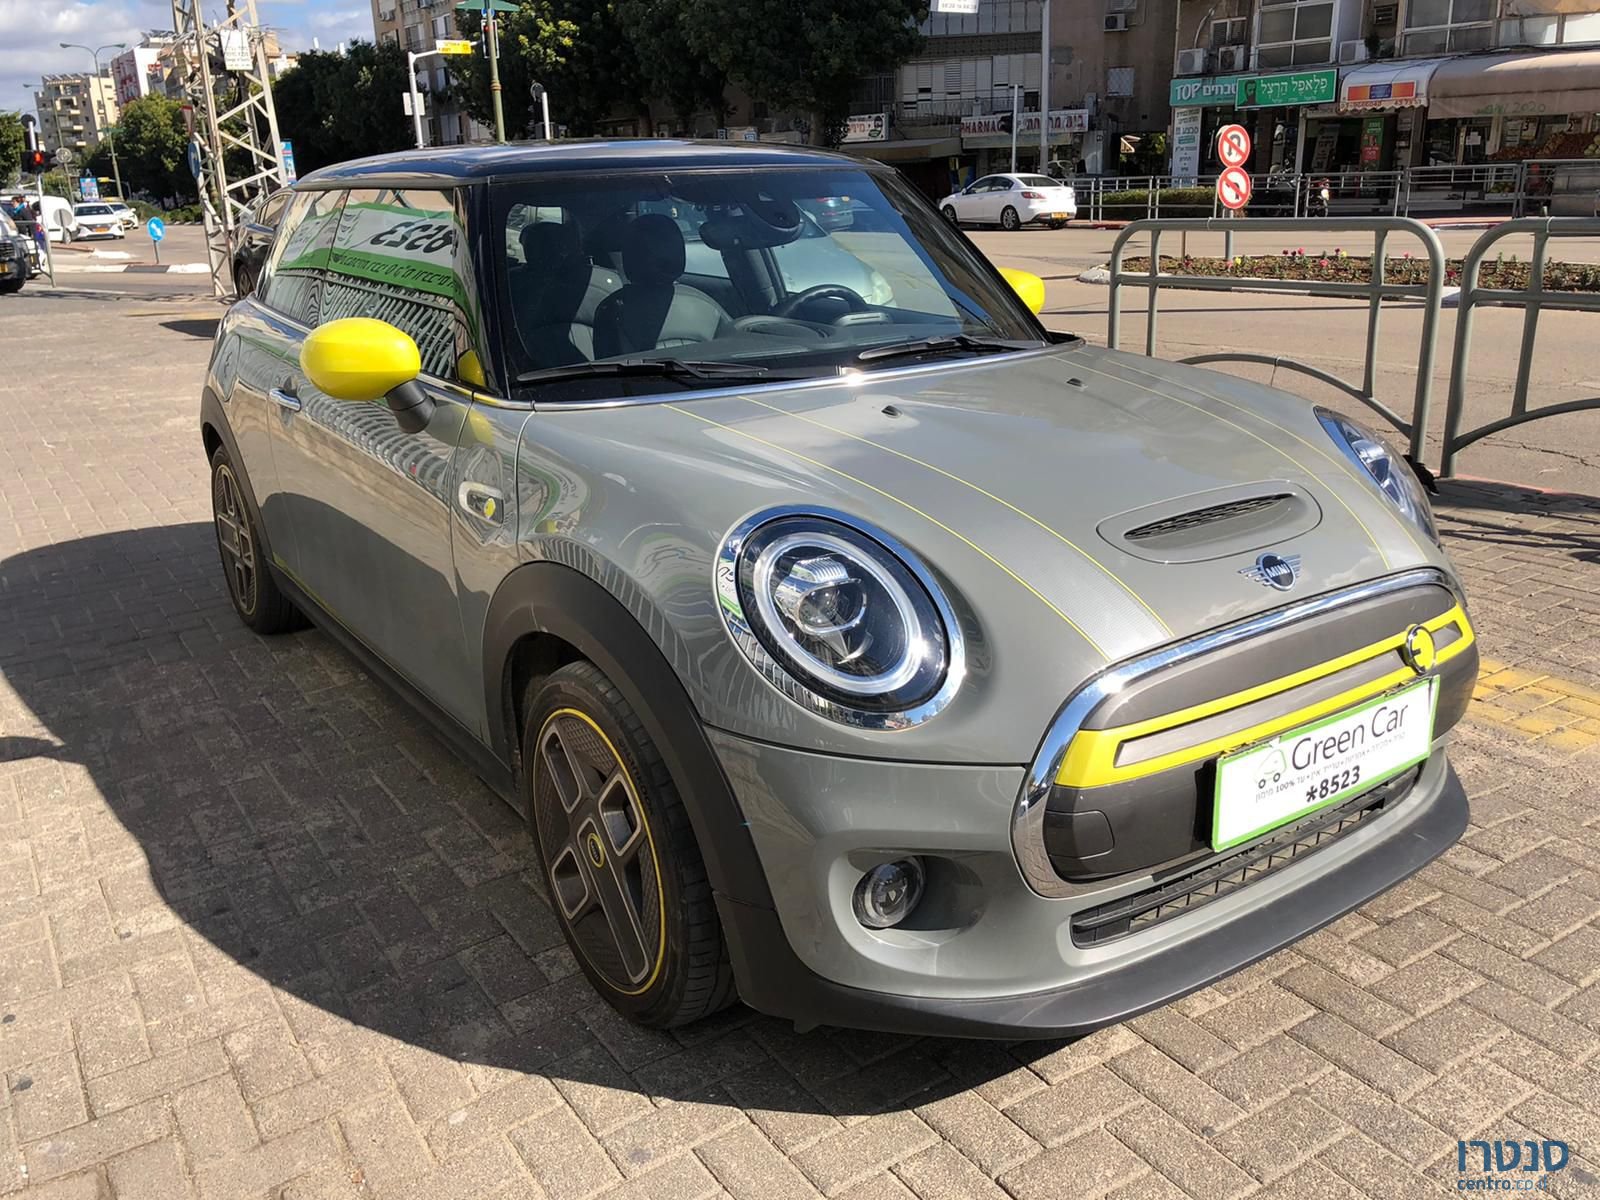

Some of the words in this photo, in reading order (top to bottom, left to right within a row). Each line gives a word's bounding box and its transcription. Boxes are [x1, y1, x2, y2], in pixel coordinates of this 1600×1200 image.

[1176, 83, 1202, 100] TOP
[1265, 563, 1290, 578] MINI
[1292, 724, 1365, 770] Green
[1371, 705, 1408, 738] Car
